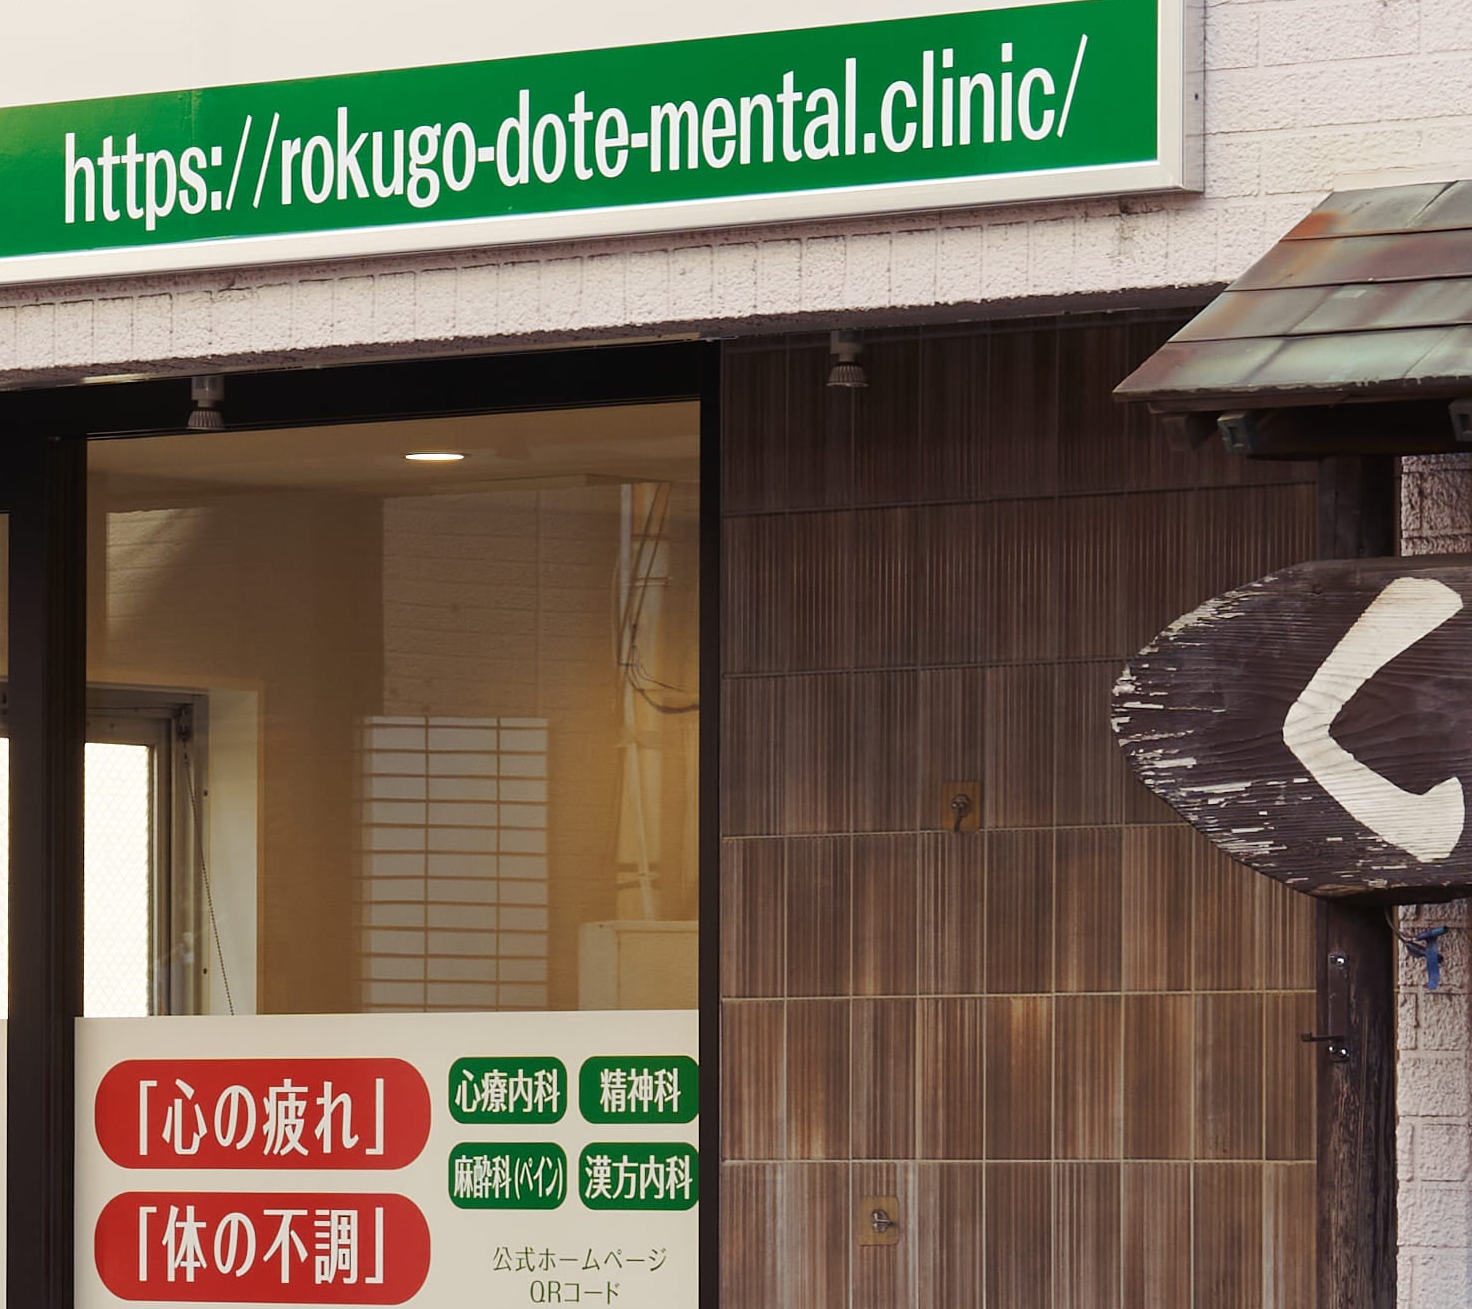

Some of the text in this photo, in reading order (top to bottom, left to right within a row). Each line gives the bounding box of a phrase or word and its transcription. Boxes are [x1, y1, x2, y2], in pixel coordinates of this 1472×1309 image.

[64, 33, 1089, 233] https://rokugo-dote-mental.clinic/
[455, 1068, 681, 1114] 心療内科 精神科
[139, 1078, 384, 1156] 「心の疲れ」
[585, 1155, 693, 1200] 漢方内科
[139, 1204, 384, 1284] 「体の不調」
[493, 1246, 667, 1272] 公式ホームページ
[530, 1280, 620, 1305] QRコード
